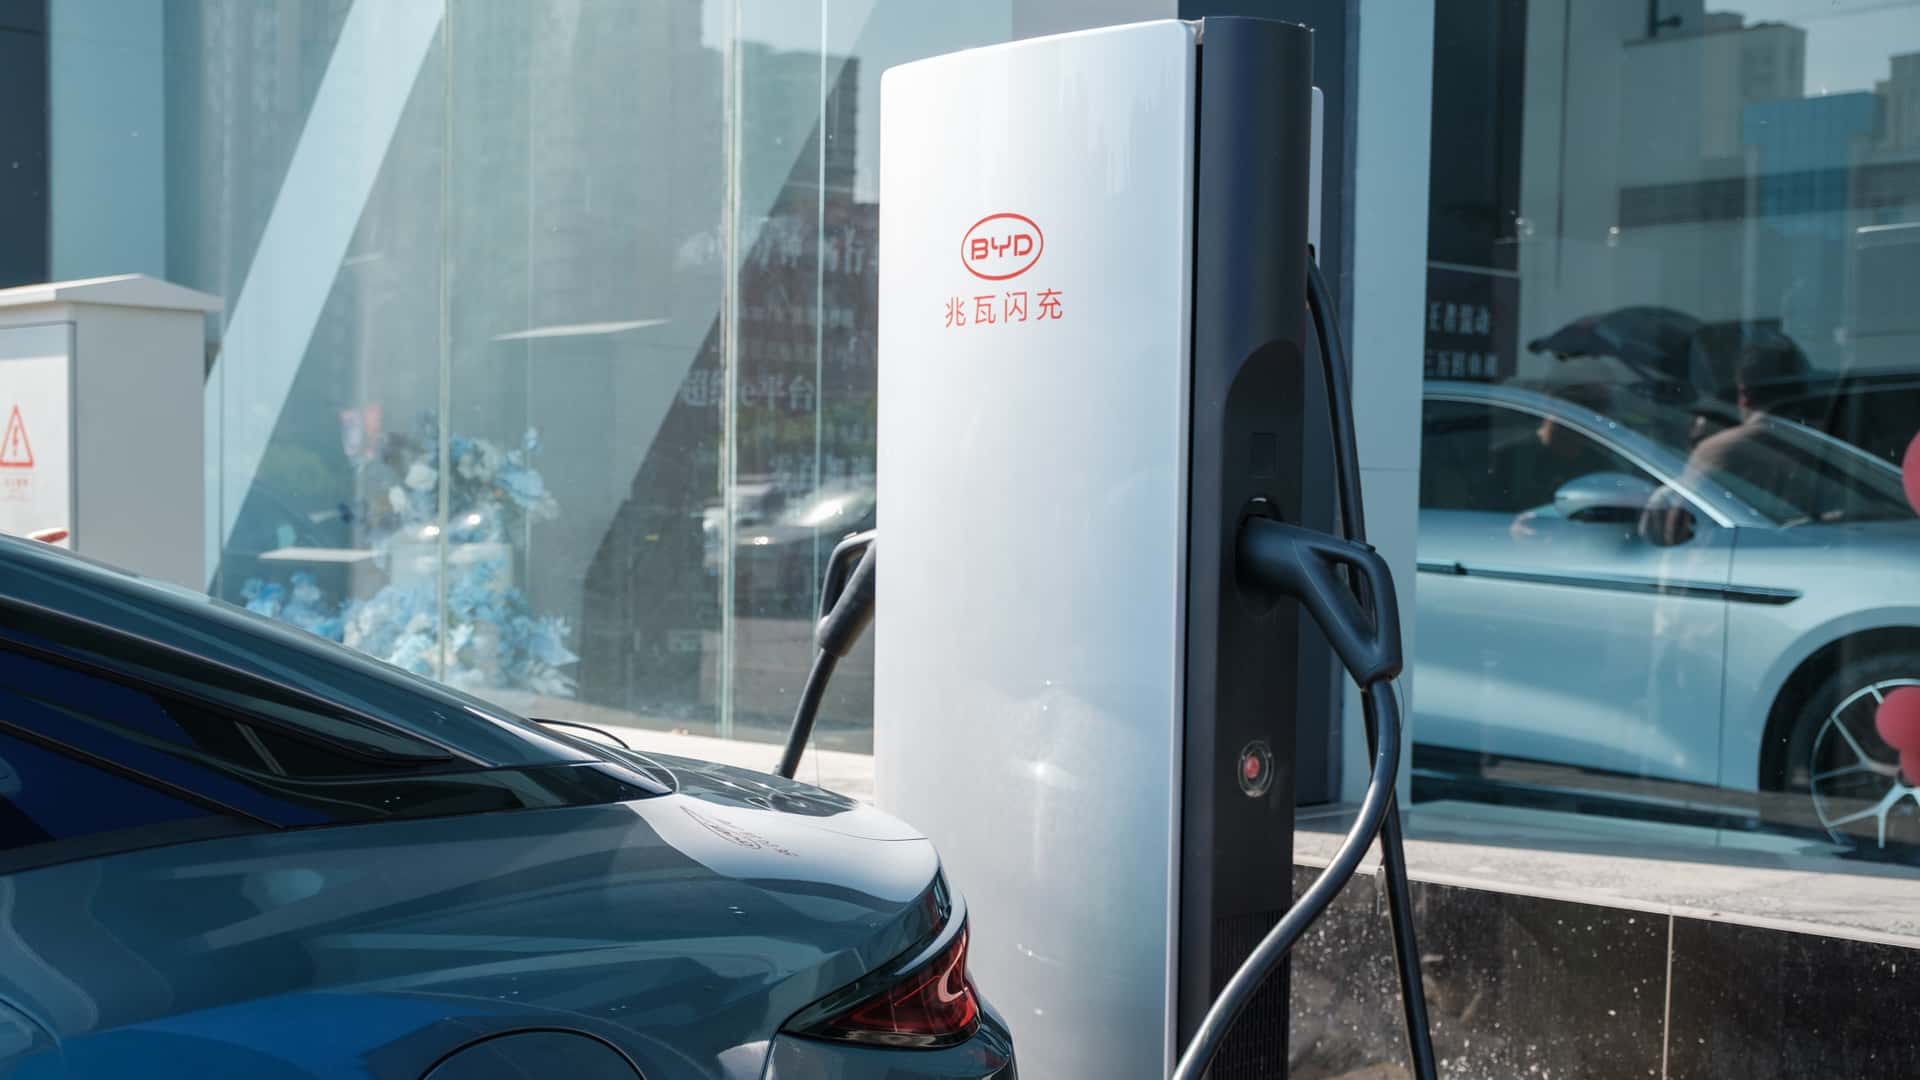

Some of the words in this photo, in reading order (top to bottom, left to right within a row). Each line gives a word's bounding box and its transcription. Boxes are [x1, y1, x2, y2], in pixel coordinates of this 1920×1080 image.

[971, 234, 1033, 260] BYD
[945, 289, 1063, 327] 兆瓦闪充
